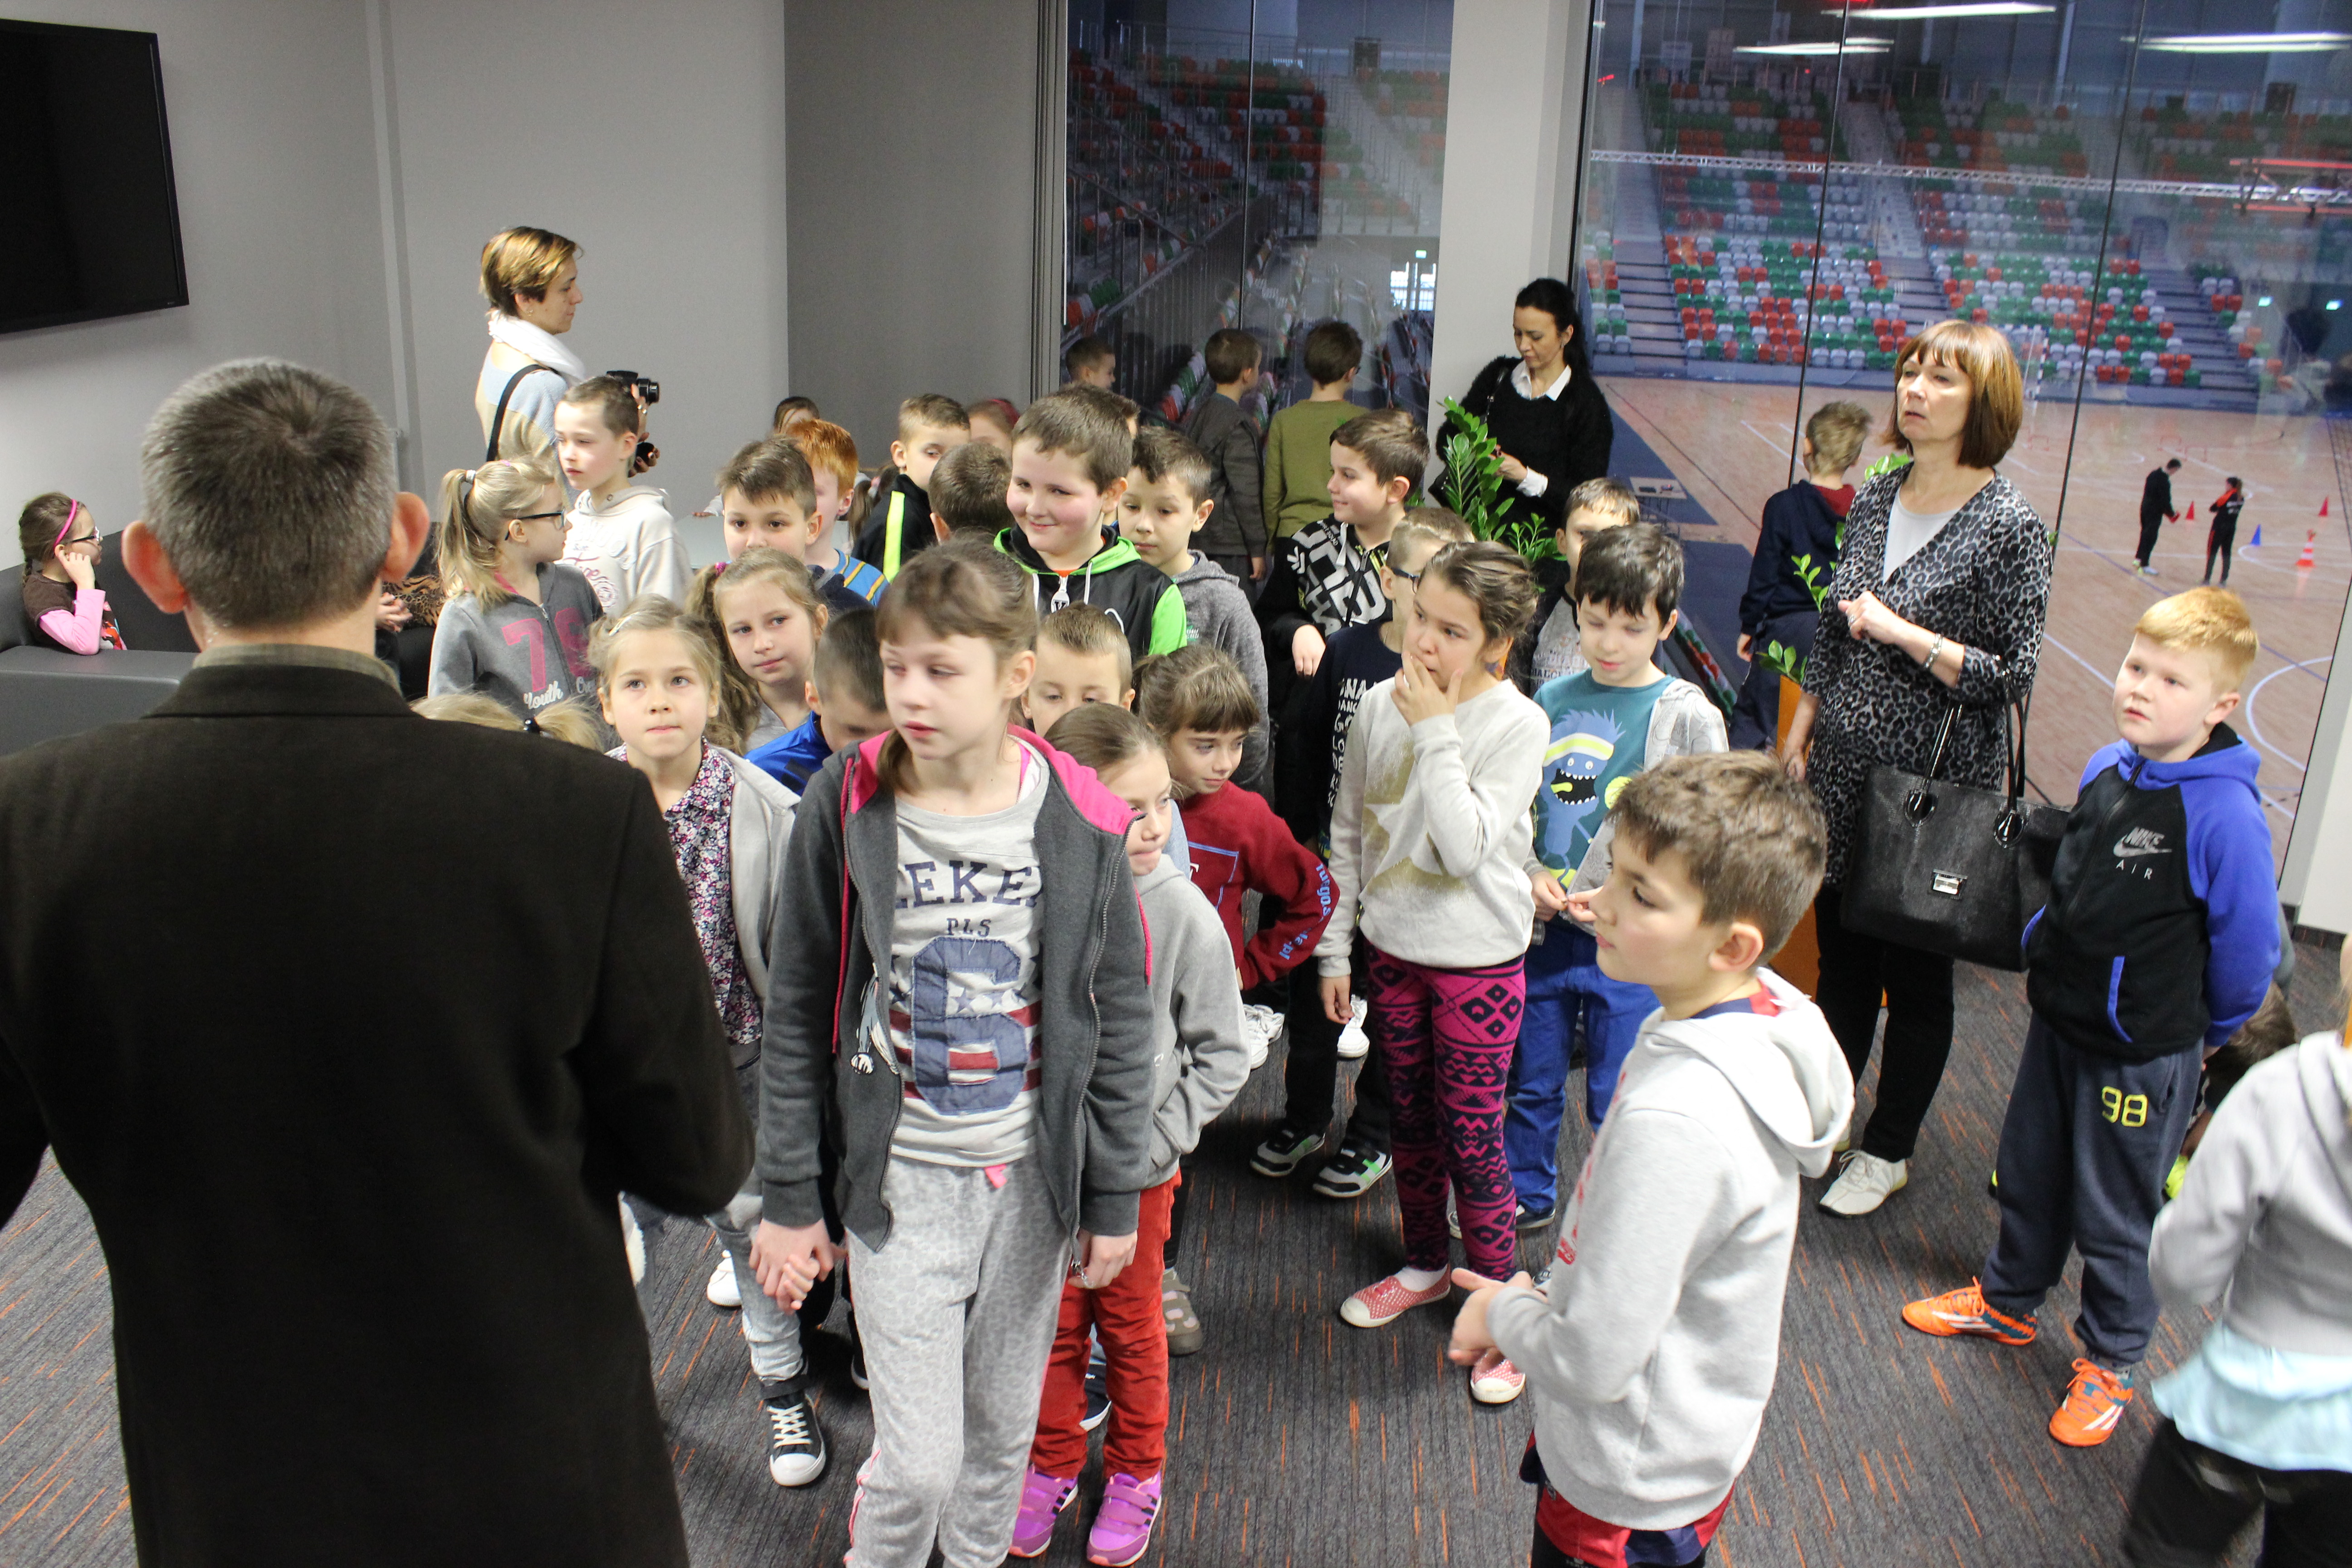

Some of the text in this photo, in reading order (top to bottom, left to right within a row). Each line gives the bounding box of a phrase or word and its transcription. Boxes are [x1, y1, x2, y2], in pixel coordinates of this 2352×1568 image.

[523, 680, 564, 710] Youth
[2123, 826, 2165, 848] NIKE
[2115, 859, 2153, 880] AIR
[895, 860, 1043, 909] EKE
[946, 918, 992, 937] PLS
[2101, 1085, 2148, 1127] 98
